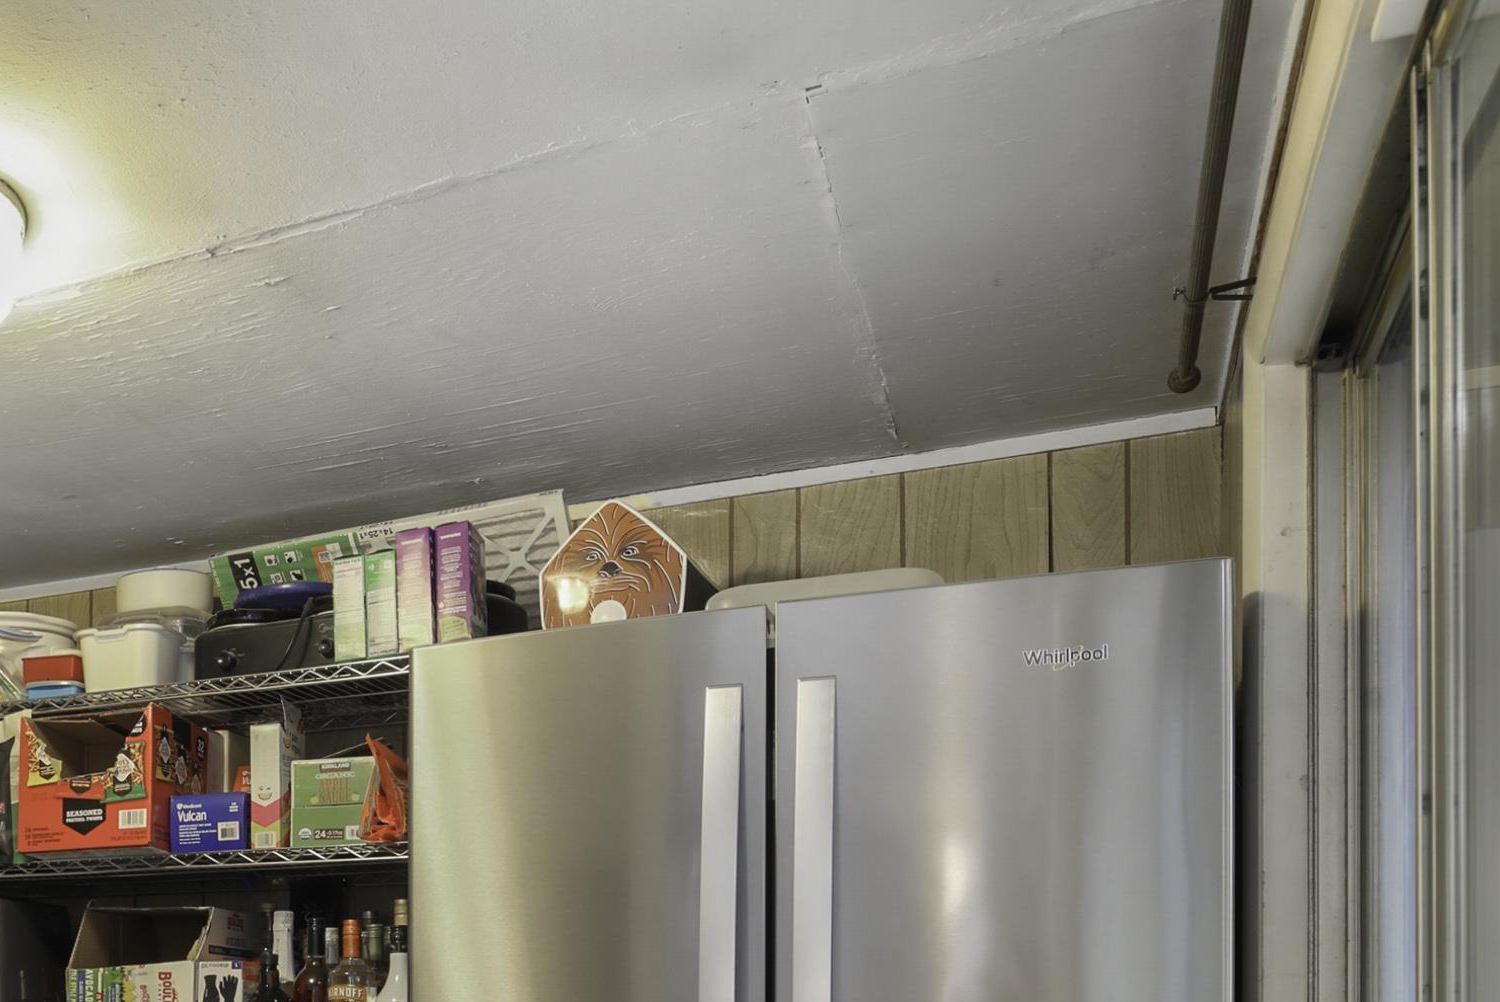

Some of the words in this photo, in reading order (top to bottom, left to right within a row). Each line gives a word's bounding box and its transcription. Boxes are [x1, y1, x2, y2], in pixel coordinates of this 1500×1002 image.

[1023, 644, 1108, 668] Whirlpool
[66, 808, 103, 818] SEASONED
[177, 810, 207, 822] Vulcan
